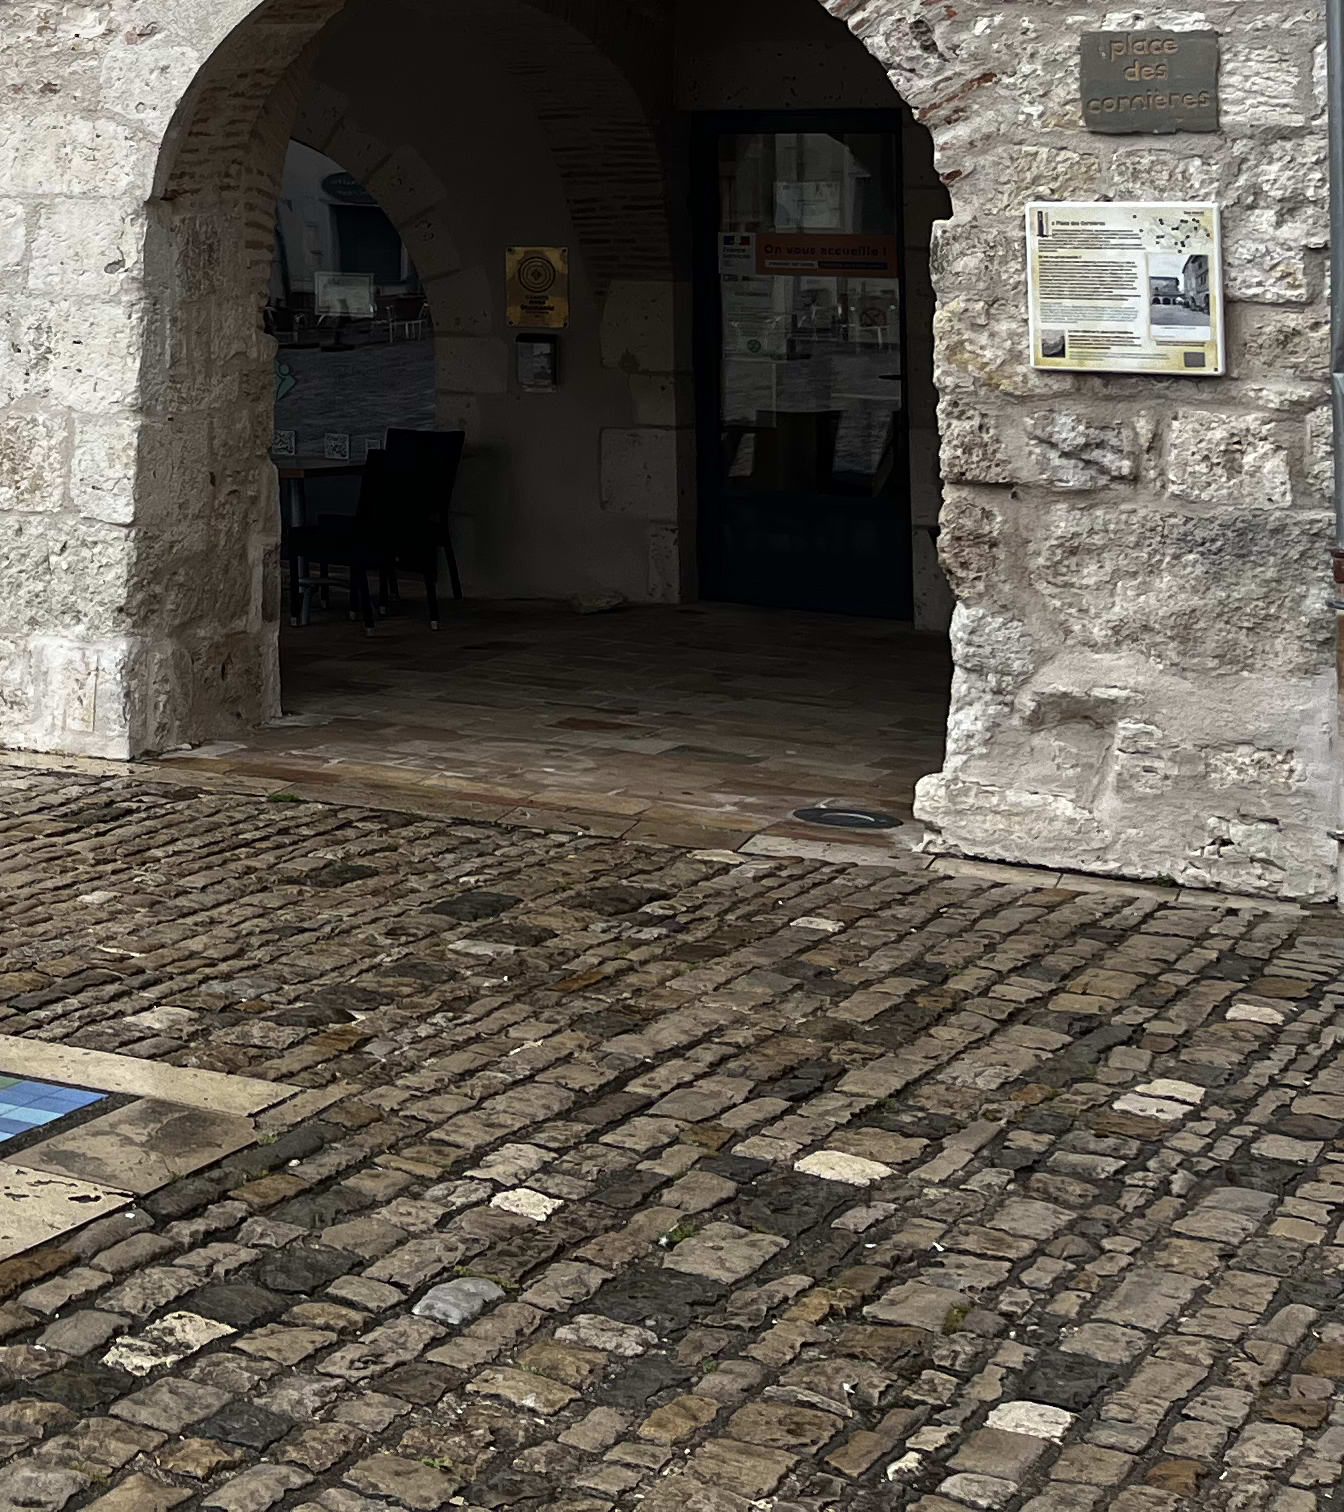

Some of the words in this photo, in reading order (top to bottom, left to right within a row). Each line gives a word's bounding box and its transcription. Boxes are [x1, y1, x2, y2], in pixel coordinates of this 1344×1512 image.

[1109, 33, 1179, 64] place
[1123, 59, 1169, 81] des
[763, 244, 783, 255] On
[786, 246, 816, 256] vous
